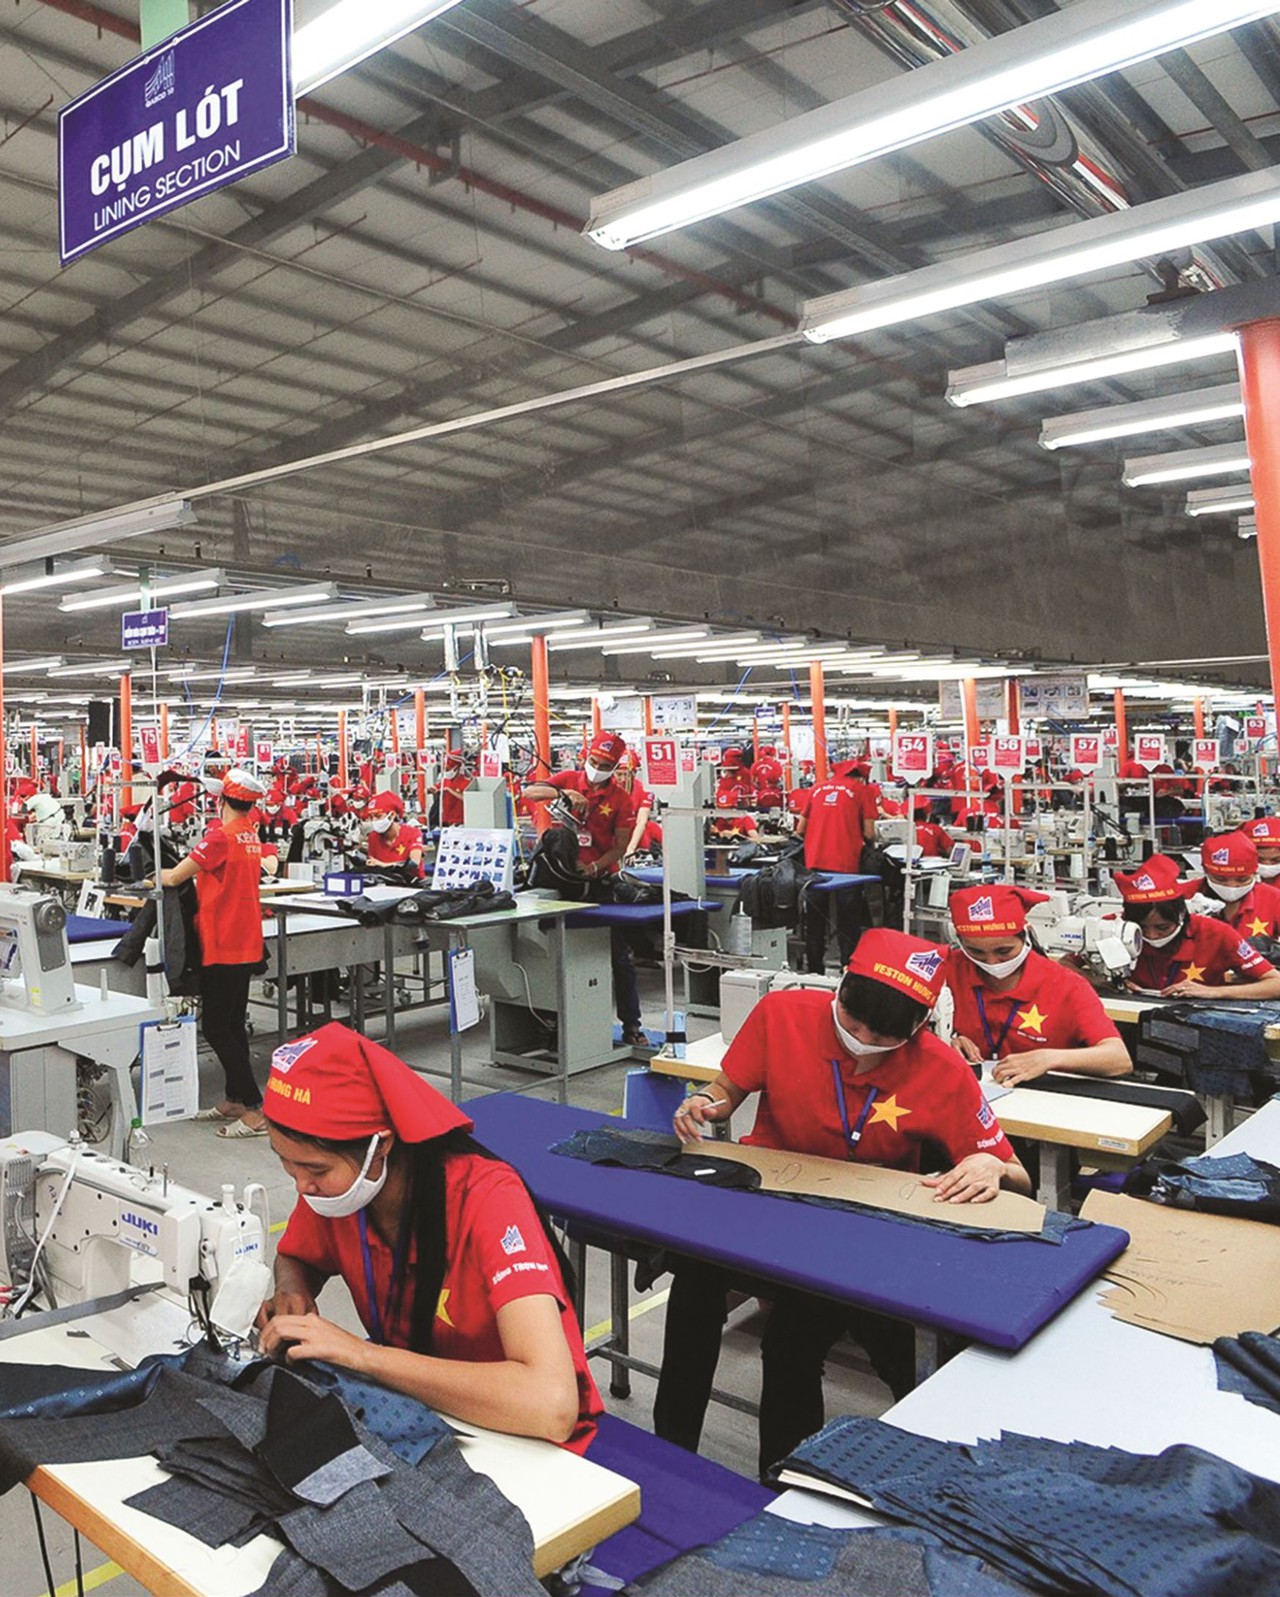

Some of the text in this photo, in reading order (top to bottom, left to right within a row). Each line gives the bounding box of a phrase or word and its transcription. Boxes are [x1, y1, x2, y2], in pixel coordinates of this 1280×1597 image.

[90, 79, 244, 197] CỤM LÓT
[94, 140, 241, 232] LINING SECTION
[142, 729, 156, 744] 75
[901, 738, 924, 751] 54
[1078, 739, 1097, 750] 57
[651, 744, 673, 761] 51
[873, 962, 913, 987] VESTON
[122, 1213, 158, 1236] JUKI
